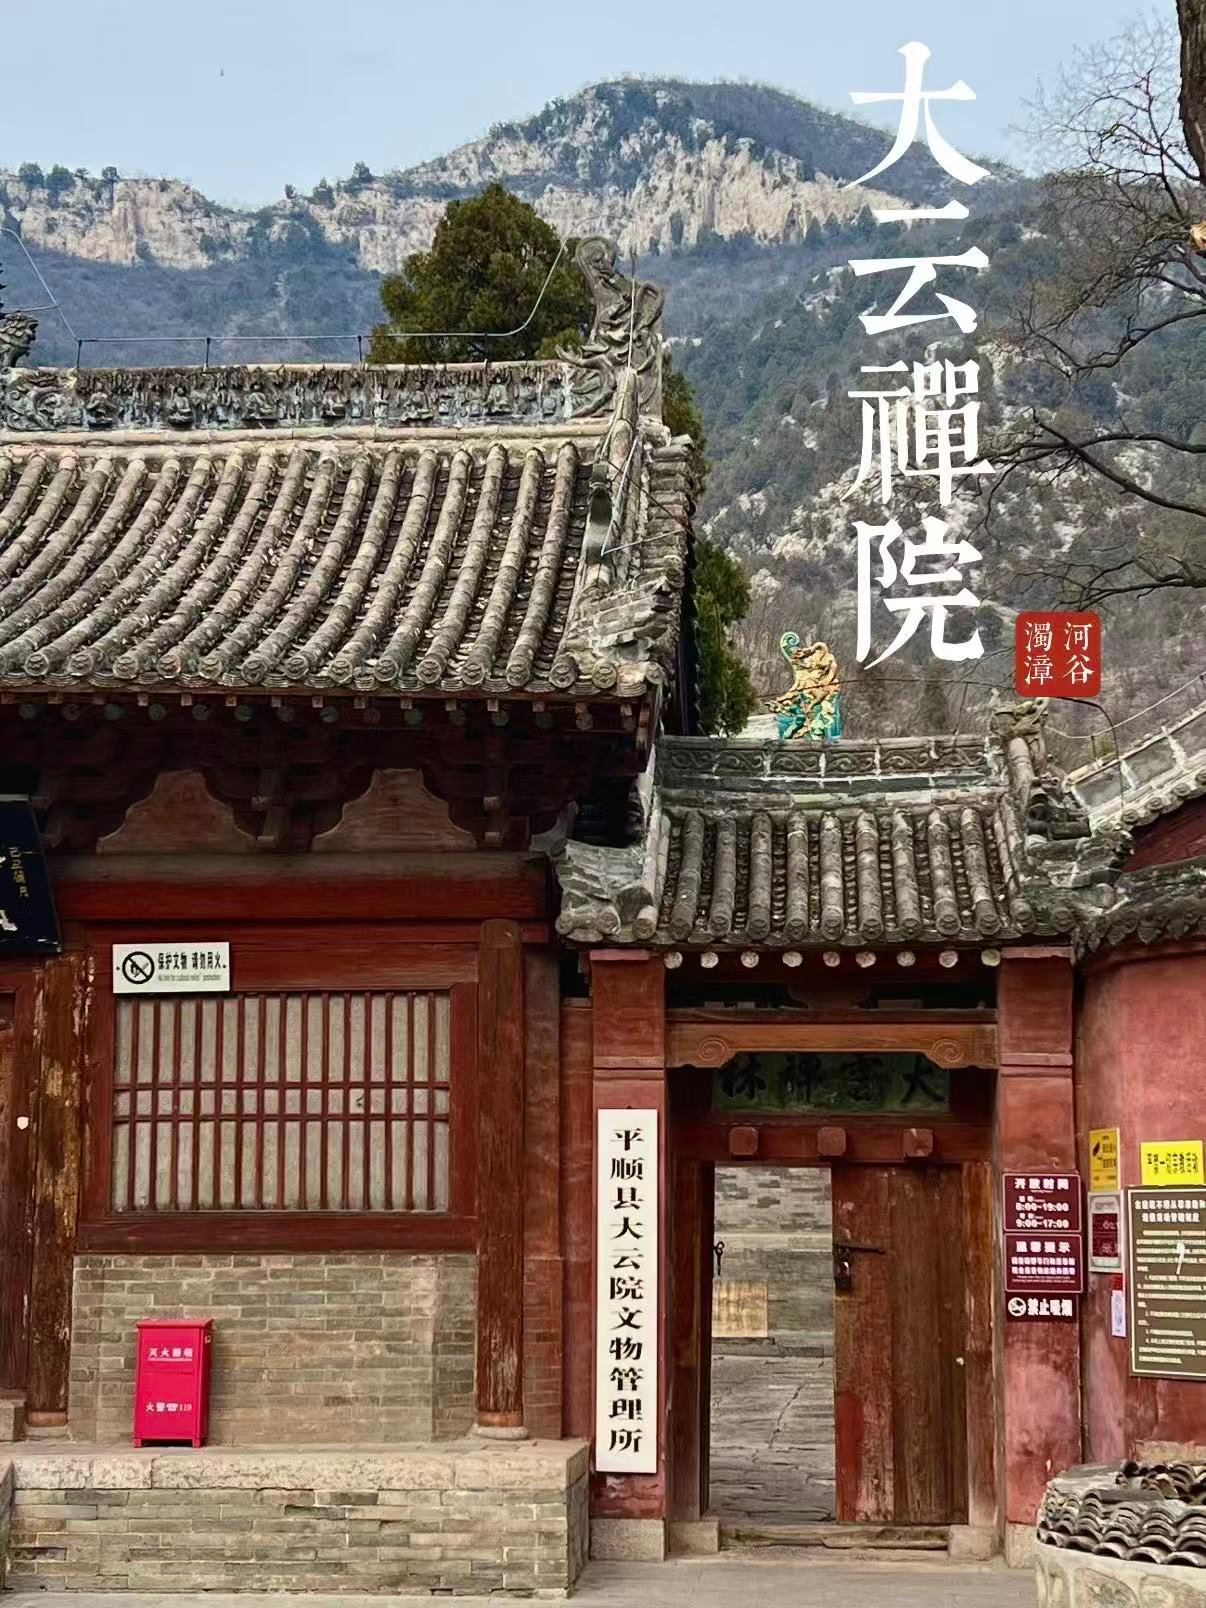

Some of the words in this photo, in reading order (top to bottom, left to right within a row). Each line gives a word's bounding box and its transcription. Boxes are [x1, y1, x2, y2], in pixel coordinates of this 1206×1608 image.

[609, 1127, 644, 1453] 平顺县大云院文物管理所
